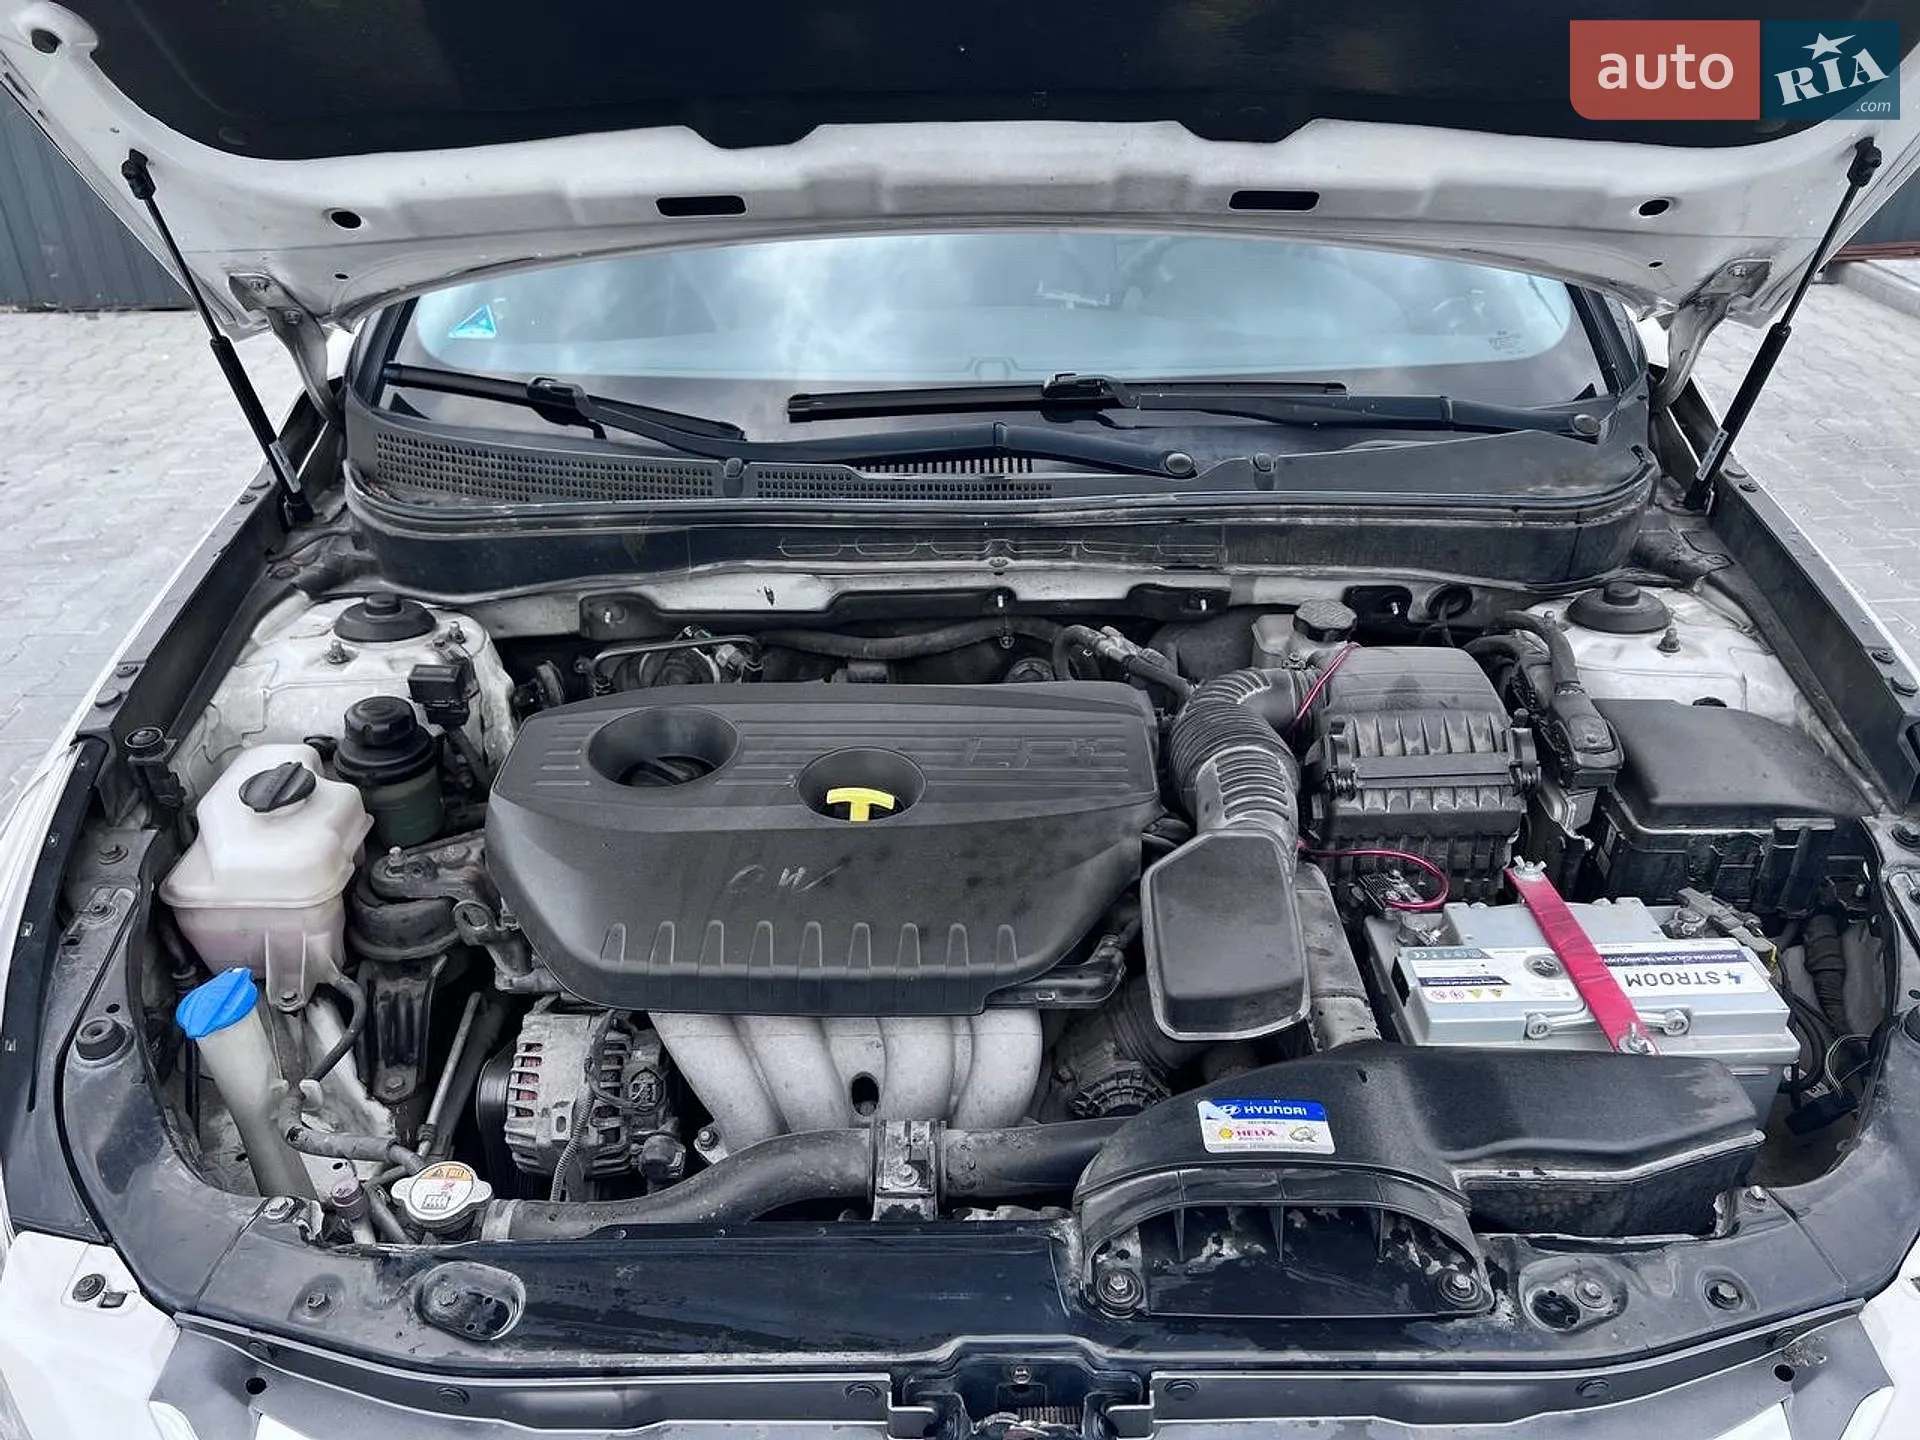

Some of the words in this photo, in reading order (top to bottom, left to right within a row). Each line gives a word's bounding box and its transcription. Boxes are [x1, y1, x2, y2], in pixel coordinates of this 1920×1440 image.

[1624, 971, 1721, 987] STROOM
[1244, 1105, 1308, 1116] HYUNDAI
[1236, 1129, 1277, 1137] HELIX
